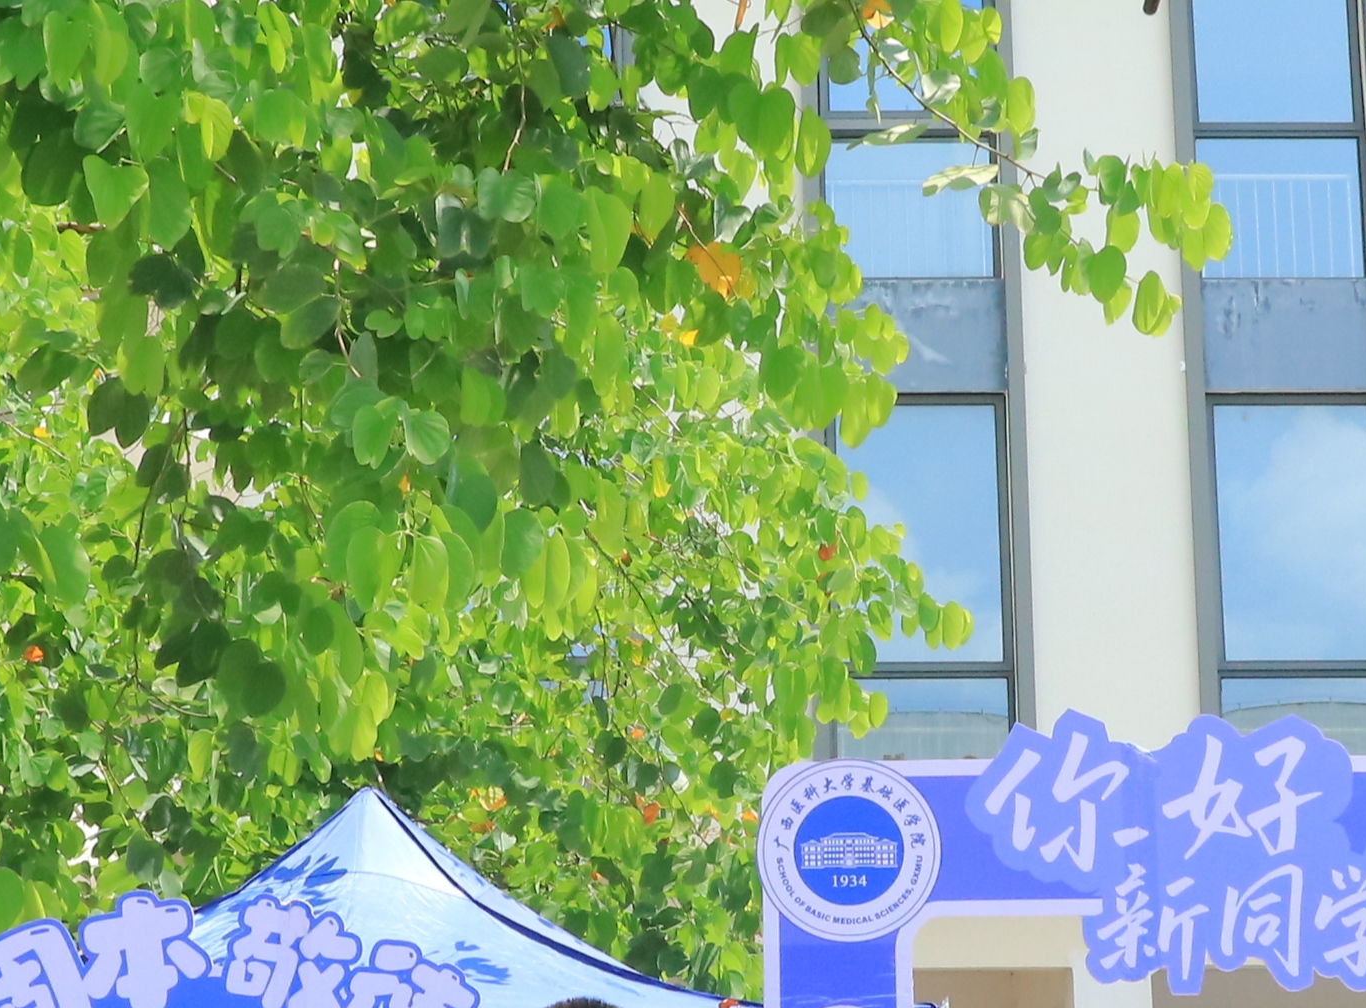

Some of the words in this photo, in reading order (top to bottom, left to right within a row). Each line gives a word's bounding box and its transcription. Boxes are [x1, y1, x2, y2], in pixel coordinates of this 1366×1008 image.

[773, 772, 927, 852] 广西医科大学基础医学院
[985, 732, 1323, 873] 你好
[776, 857, 795, 899] SCHOOL
[794, 896, 806, 907] OF
[805, 904, 831, 923] BASIC
[832, 911, 874, 926] MEDICAL
[874, 888, 914, 919] SCIENCES,
[910, 855, 923, 886] GXMU
[832, 875, 868, 888] 1934
